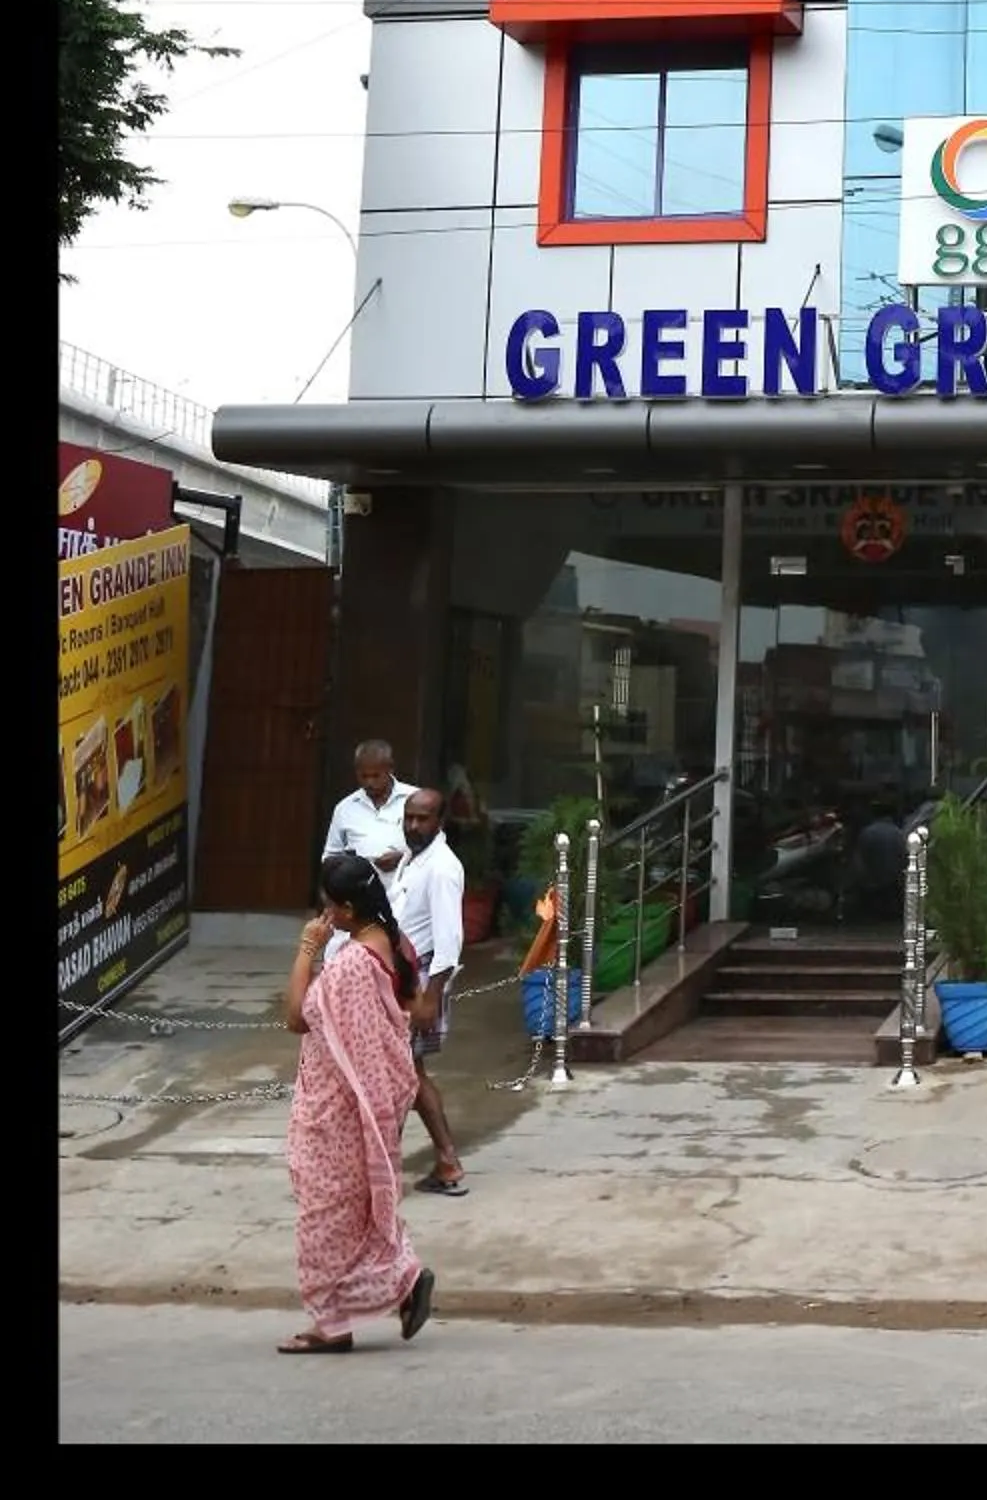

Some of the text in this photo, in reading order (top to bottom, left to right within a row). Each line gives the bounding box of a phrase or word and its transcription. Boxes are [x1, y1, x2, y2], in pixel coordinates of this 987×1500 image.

[505, 307, 818, 398] GREEN
[90, 552, 157, 606] GRANDE
[161, 543, 187, 581] INN
[69, 624, 103, 653] Rooms
[93, 912, 131, 968] BHAVAN
